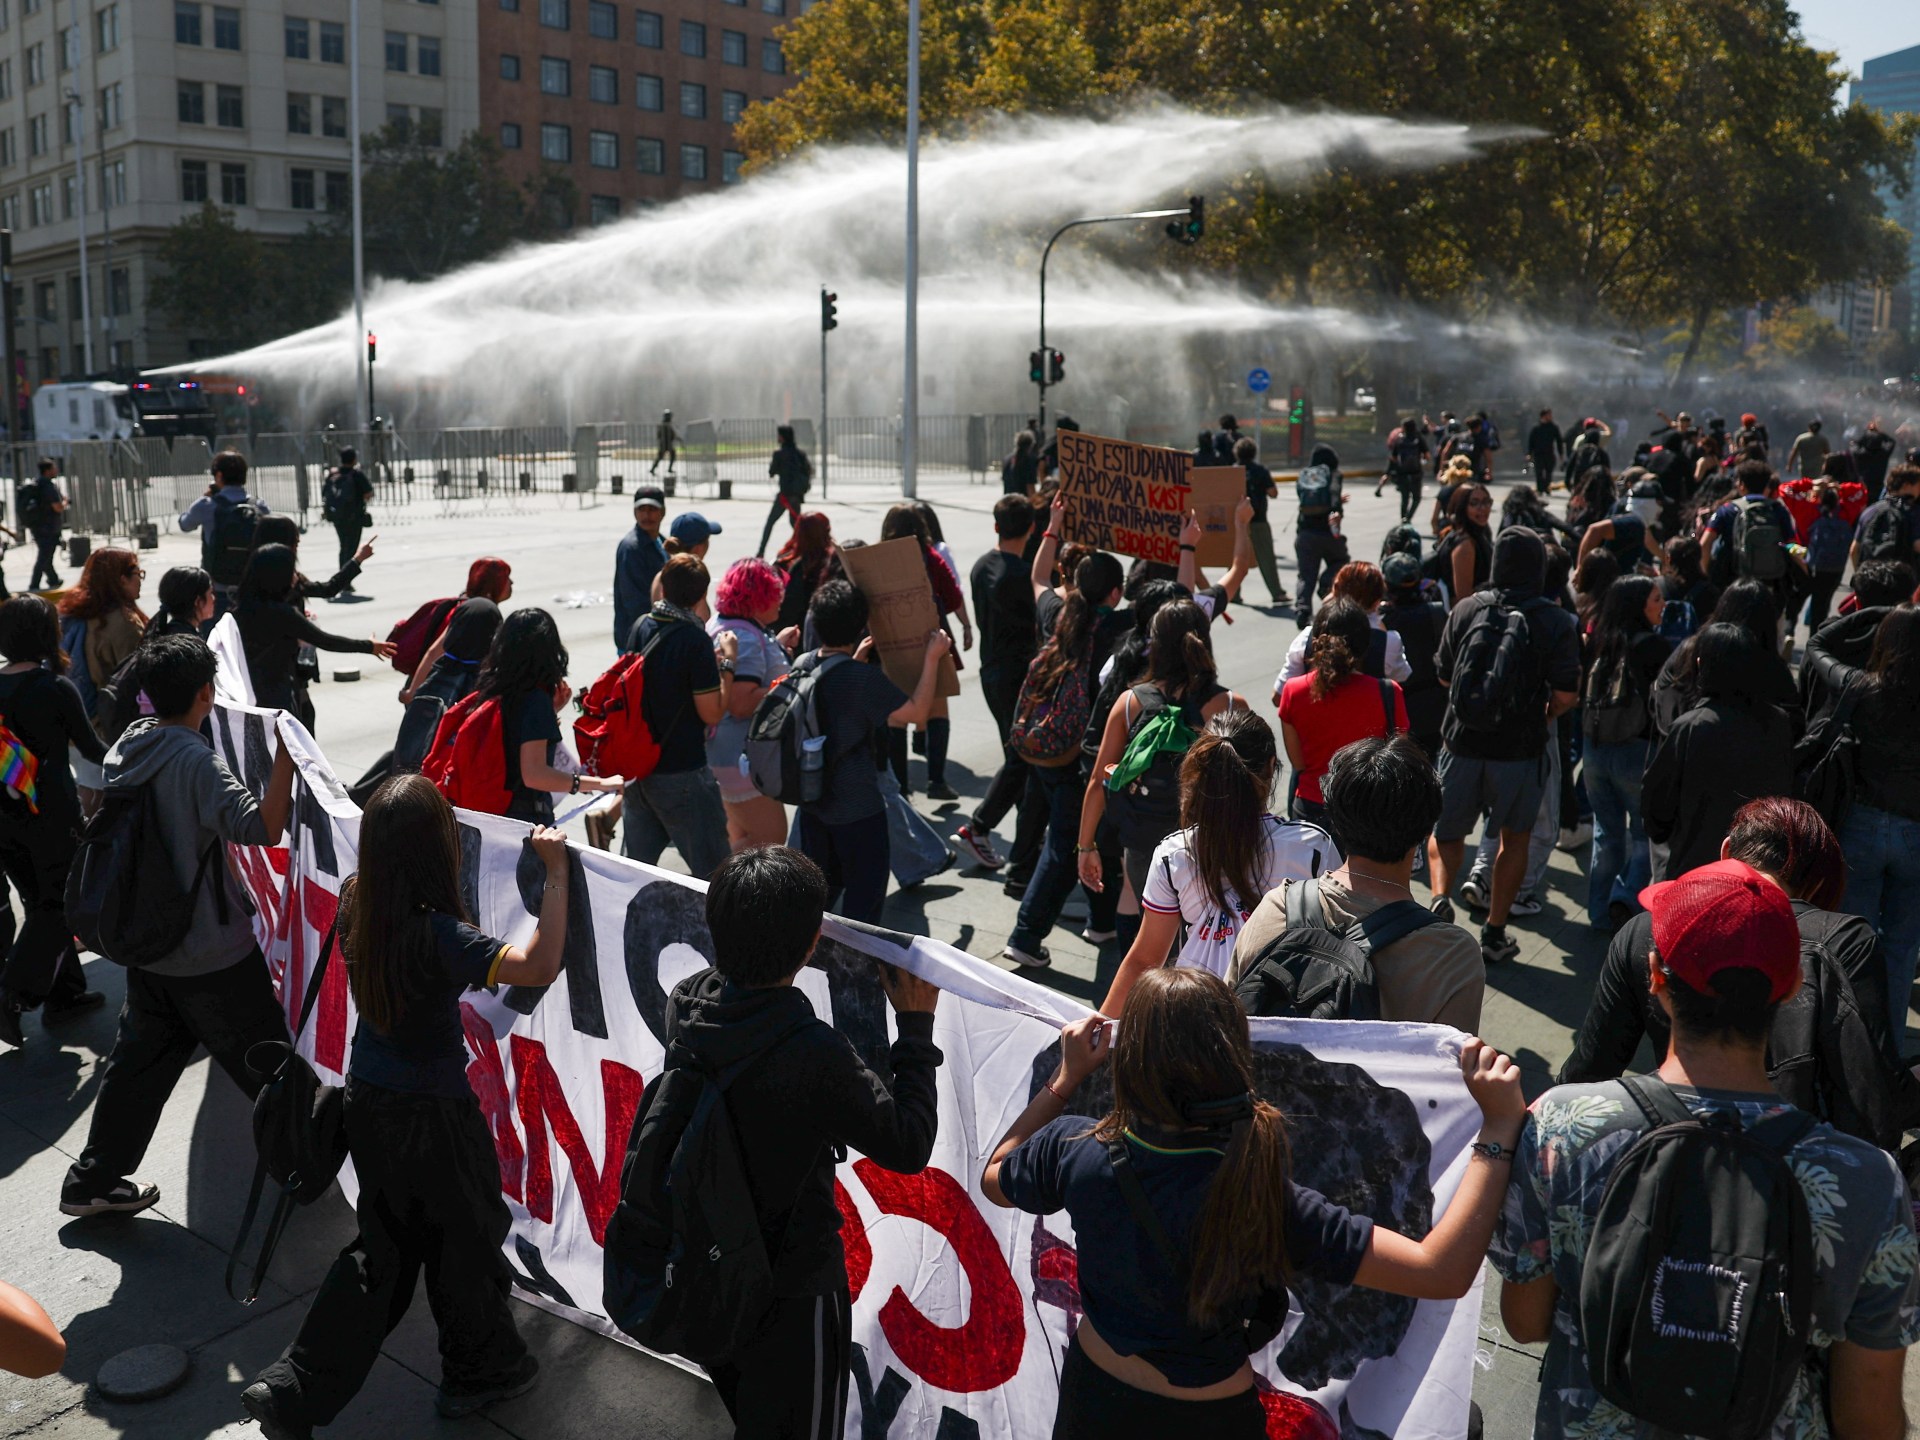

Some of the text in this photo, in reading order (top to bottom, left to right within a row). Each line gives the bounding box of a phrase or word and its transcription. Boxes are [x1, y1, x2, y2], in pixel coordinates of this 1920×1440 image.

[1062, 436, 1193, 486] SER ESTUDIANTE
[1081, 497, 1107, 522] UNA
[1149, 484, 1193, 512] KAST
[1064, 512, 1180, 566] HASTA BIOLÓGIC
